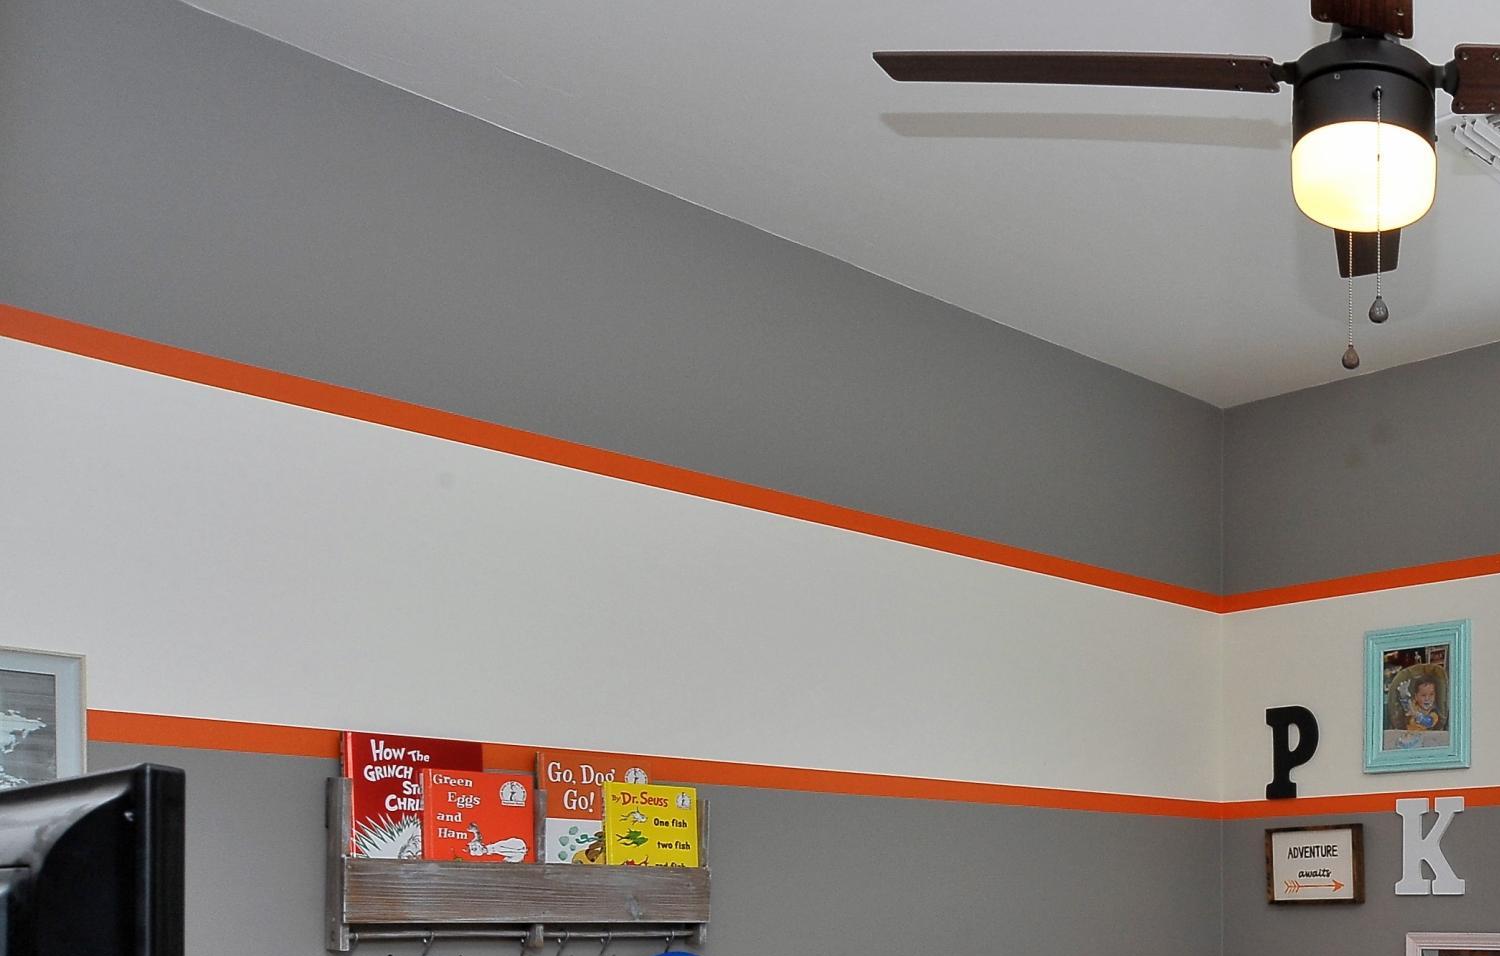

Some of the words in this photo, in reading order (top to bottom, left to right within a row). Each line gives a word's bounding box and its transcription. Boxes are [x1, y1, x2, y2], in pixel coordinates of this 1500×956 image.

[408, 750, 430, 762] The
[1265, 705, 1319, 800] P
[364, 764, 413, 782] GRINCH
[433, 773, 473, 788] Green
[547, 761, 576, 785] Go,
[448, 792, 481, 808] Eggs
[563, 789, 595, 813] Go!
[621, 792, 638, 805] Dr.
[640, 791, 669, 807] Seuss
[437, 812, 462, 823] and
[653, 817, 669, 826] One
[672, 818, 687, 828] fish
[438, 828, 468, 840] Ham
[657, 841, 672, 849] two
[675, 841, 690, 850] fish
[1287, 845, 1339, 859] ADVENTURE
[1395, 797, 1465, 895] K
[1297, 868, 1332, 879] awaits
